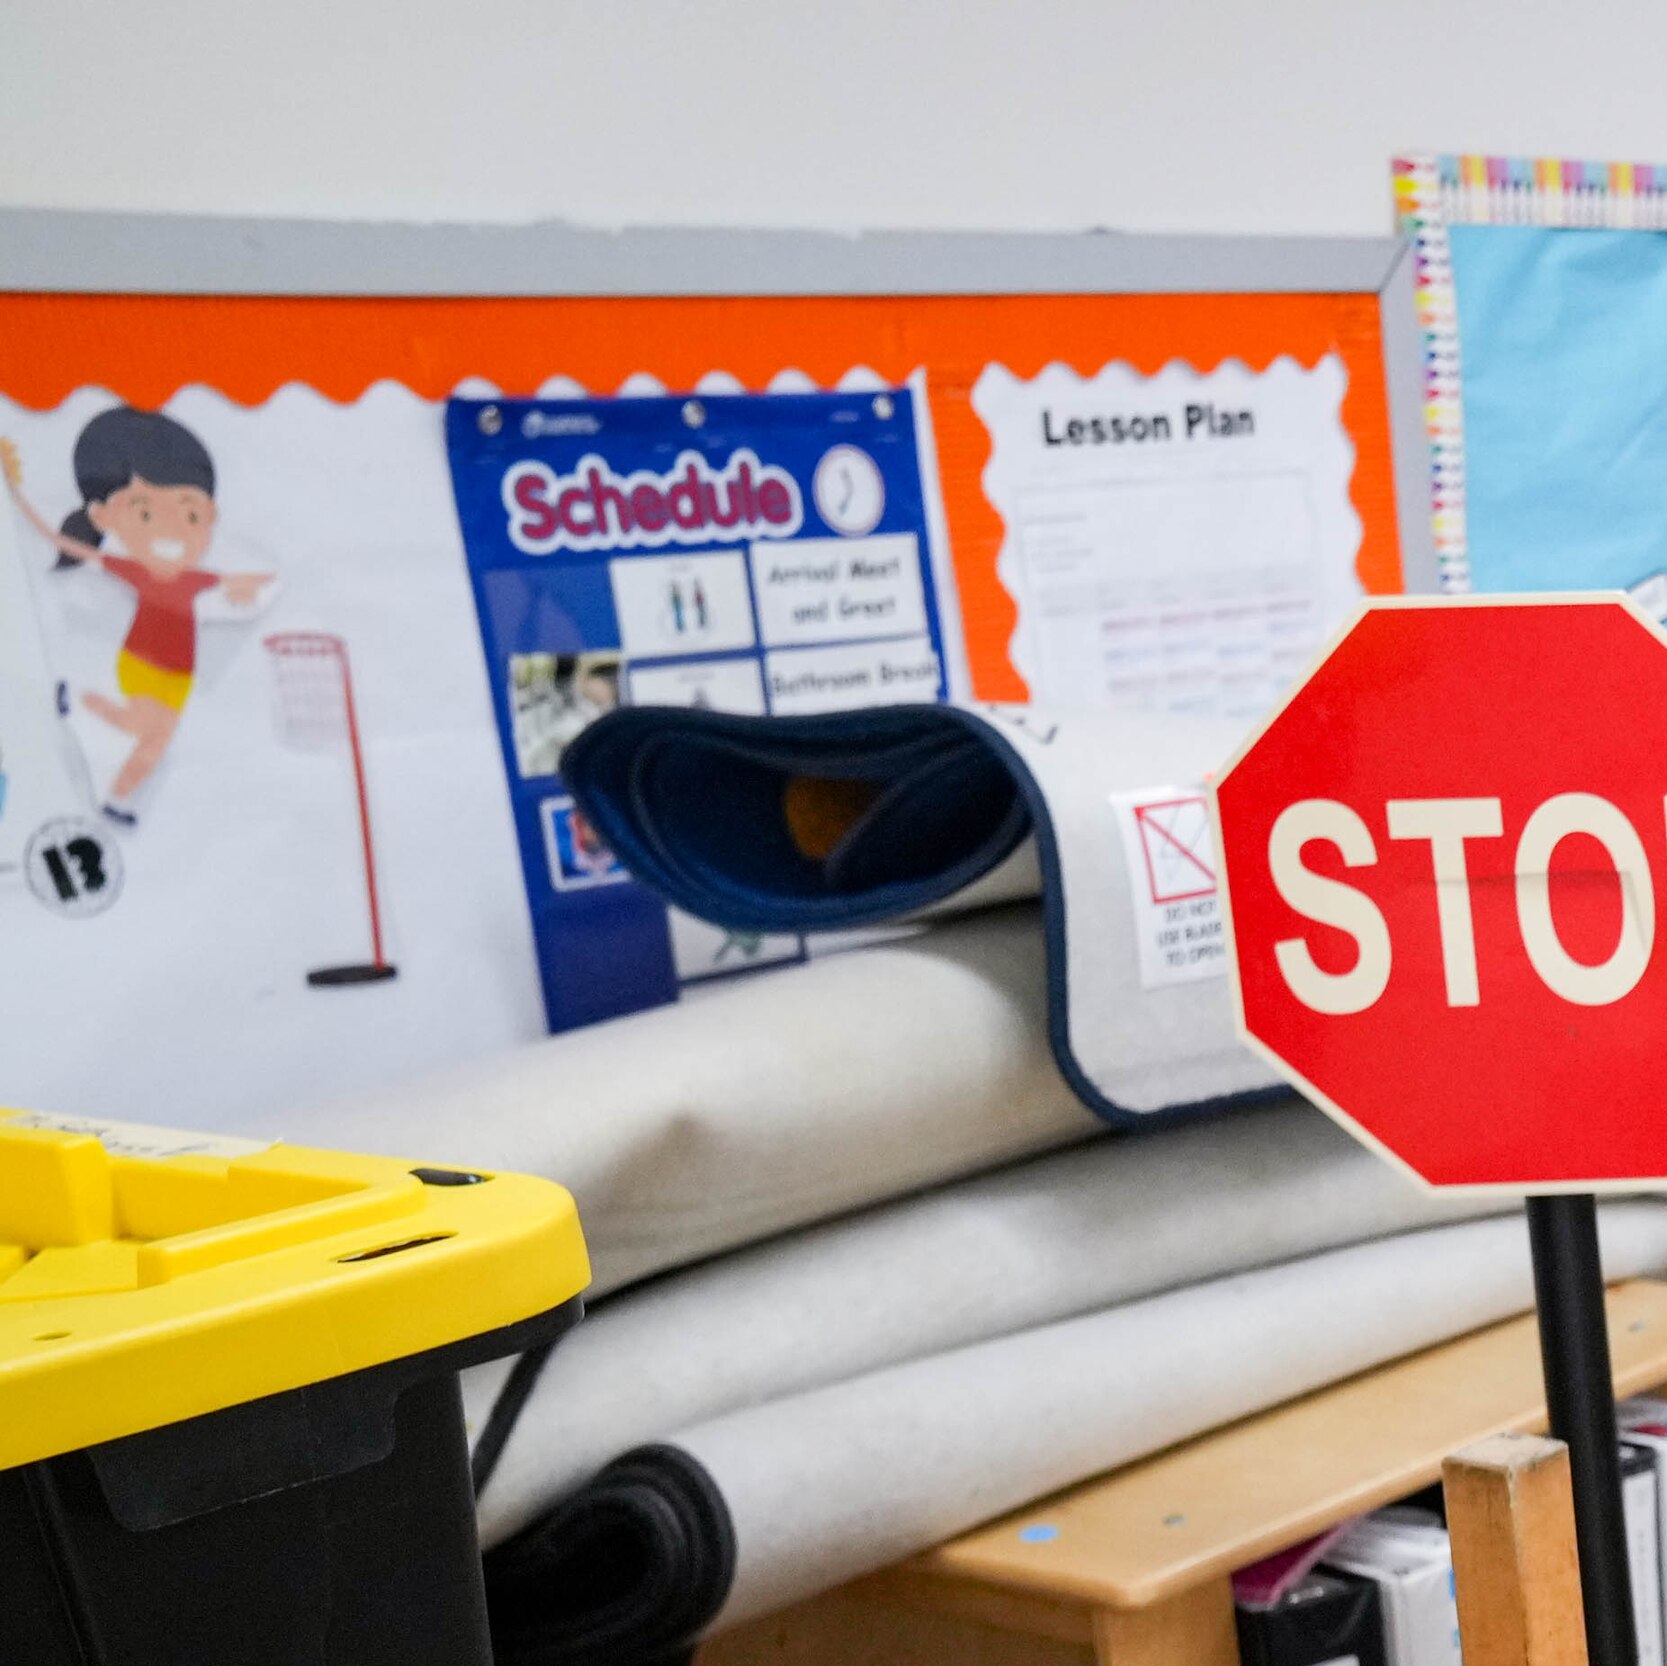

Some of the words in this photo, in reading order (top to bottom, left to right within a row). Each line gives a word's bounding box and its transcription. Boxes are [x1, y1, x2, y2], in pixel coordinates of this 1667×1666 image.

[1042, 406, 1171, 447] Lesson
[1185, 403, 1254, 440] Plan
[514, 460, 793, 540] Schedule
